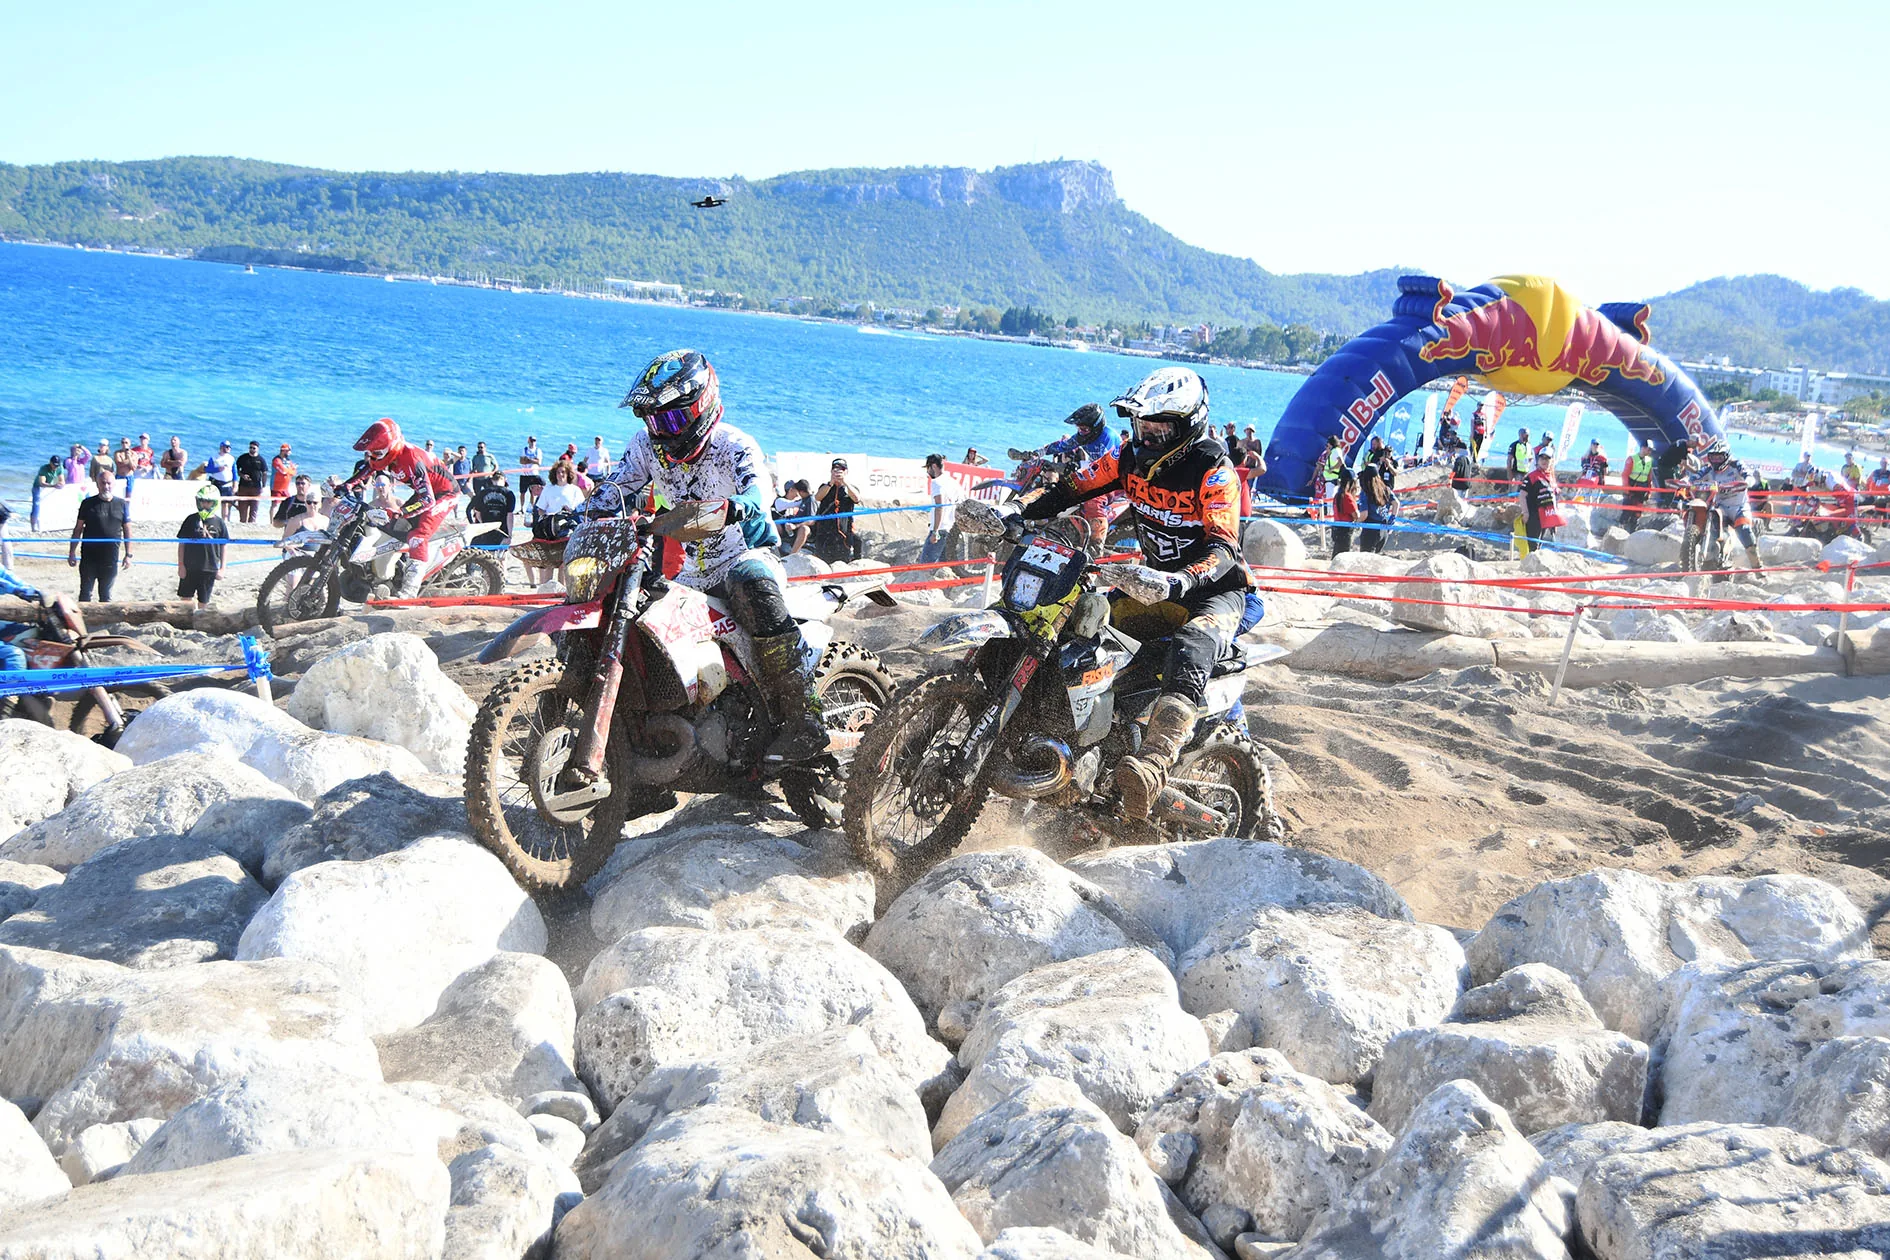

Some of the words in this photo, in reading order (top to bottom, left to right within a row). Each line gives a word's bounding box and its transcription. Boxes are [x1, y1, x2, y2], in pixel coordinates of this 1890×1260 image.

[1347, 370, 1395, 428] Bull
[1339, 414, 1361, 458] ed
[1126, 473, 1195, 513] FASTOS
[963, 704, 999, 760] JARVIS
